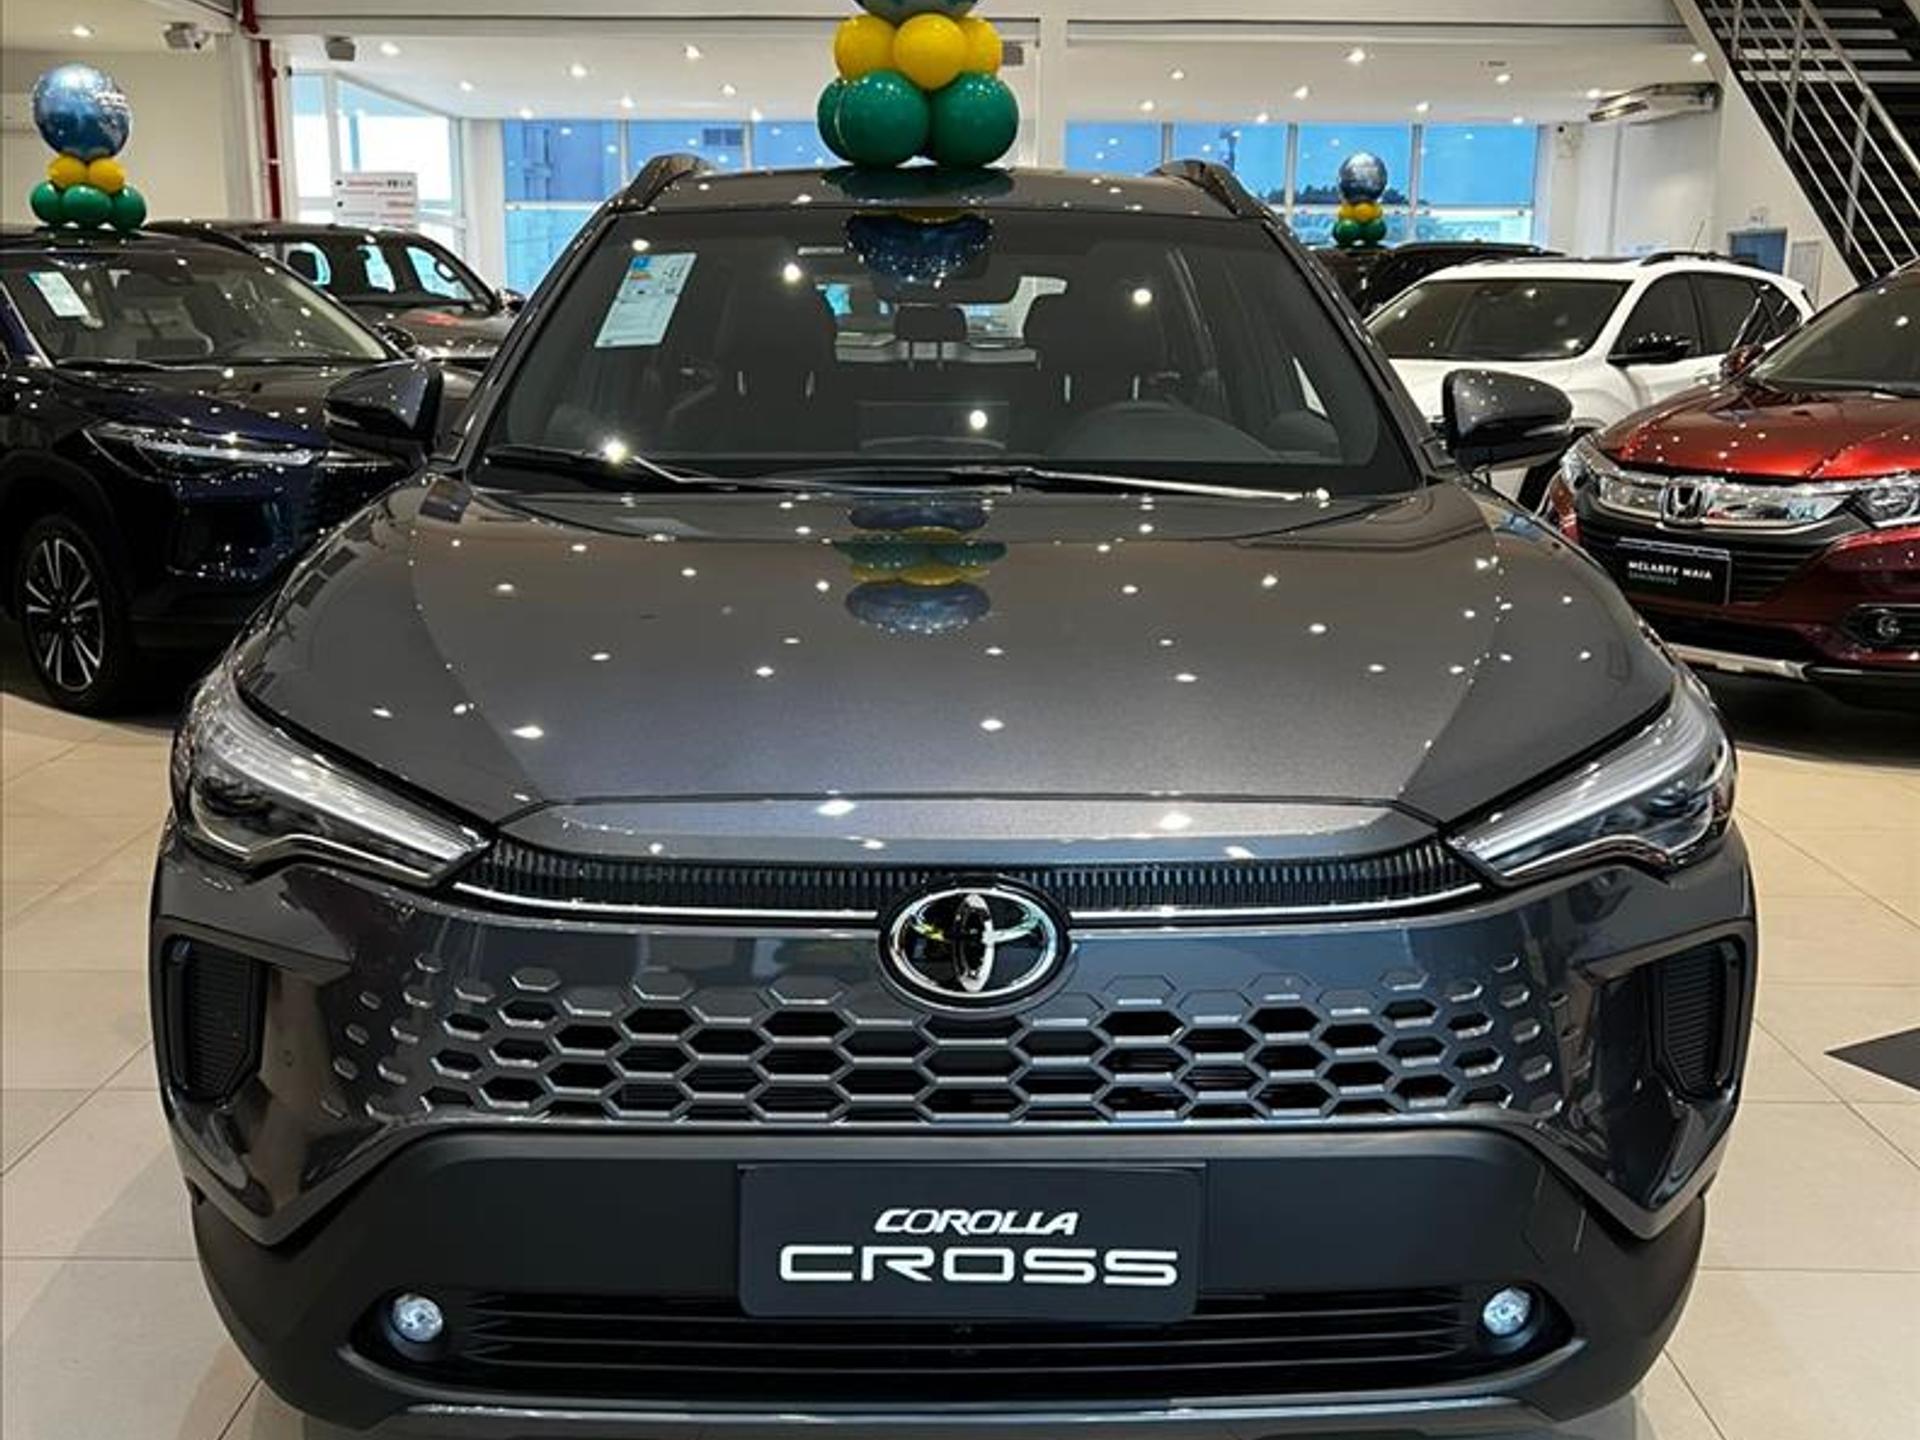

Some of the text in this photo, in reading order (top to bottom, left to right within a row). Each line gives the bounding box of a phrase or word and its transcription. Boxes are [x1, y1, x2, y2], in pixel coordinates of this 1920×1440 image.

[1682, 568, 1712, 580] MAIA
[874, 1208, 1078, 1236] COROLLA
[780, 1245, 1178, 1286] CROSS
